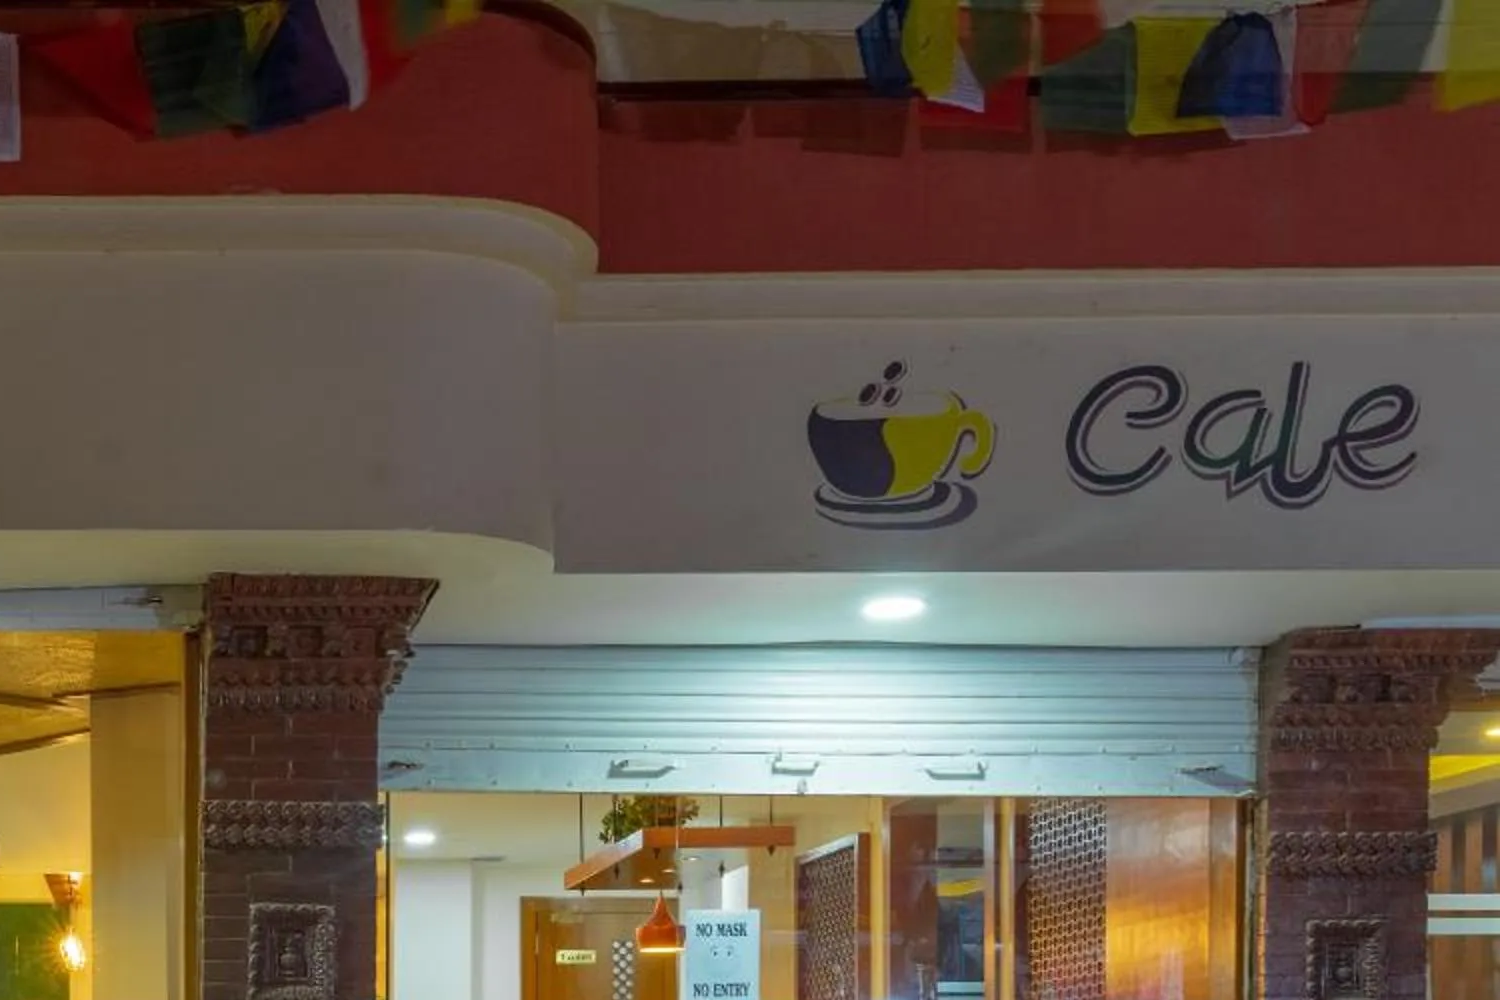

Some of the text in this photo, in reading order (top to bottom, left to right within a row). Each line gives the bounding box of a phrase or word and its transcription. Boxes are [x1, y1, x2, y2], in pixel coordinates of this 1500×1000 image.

[695, 922, 748, 938] NO MASK
[693, 982, 751, 998] NO ENTRY
